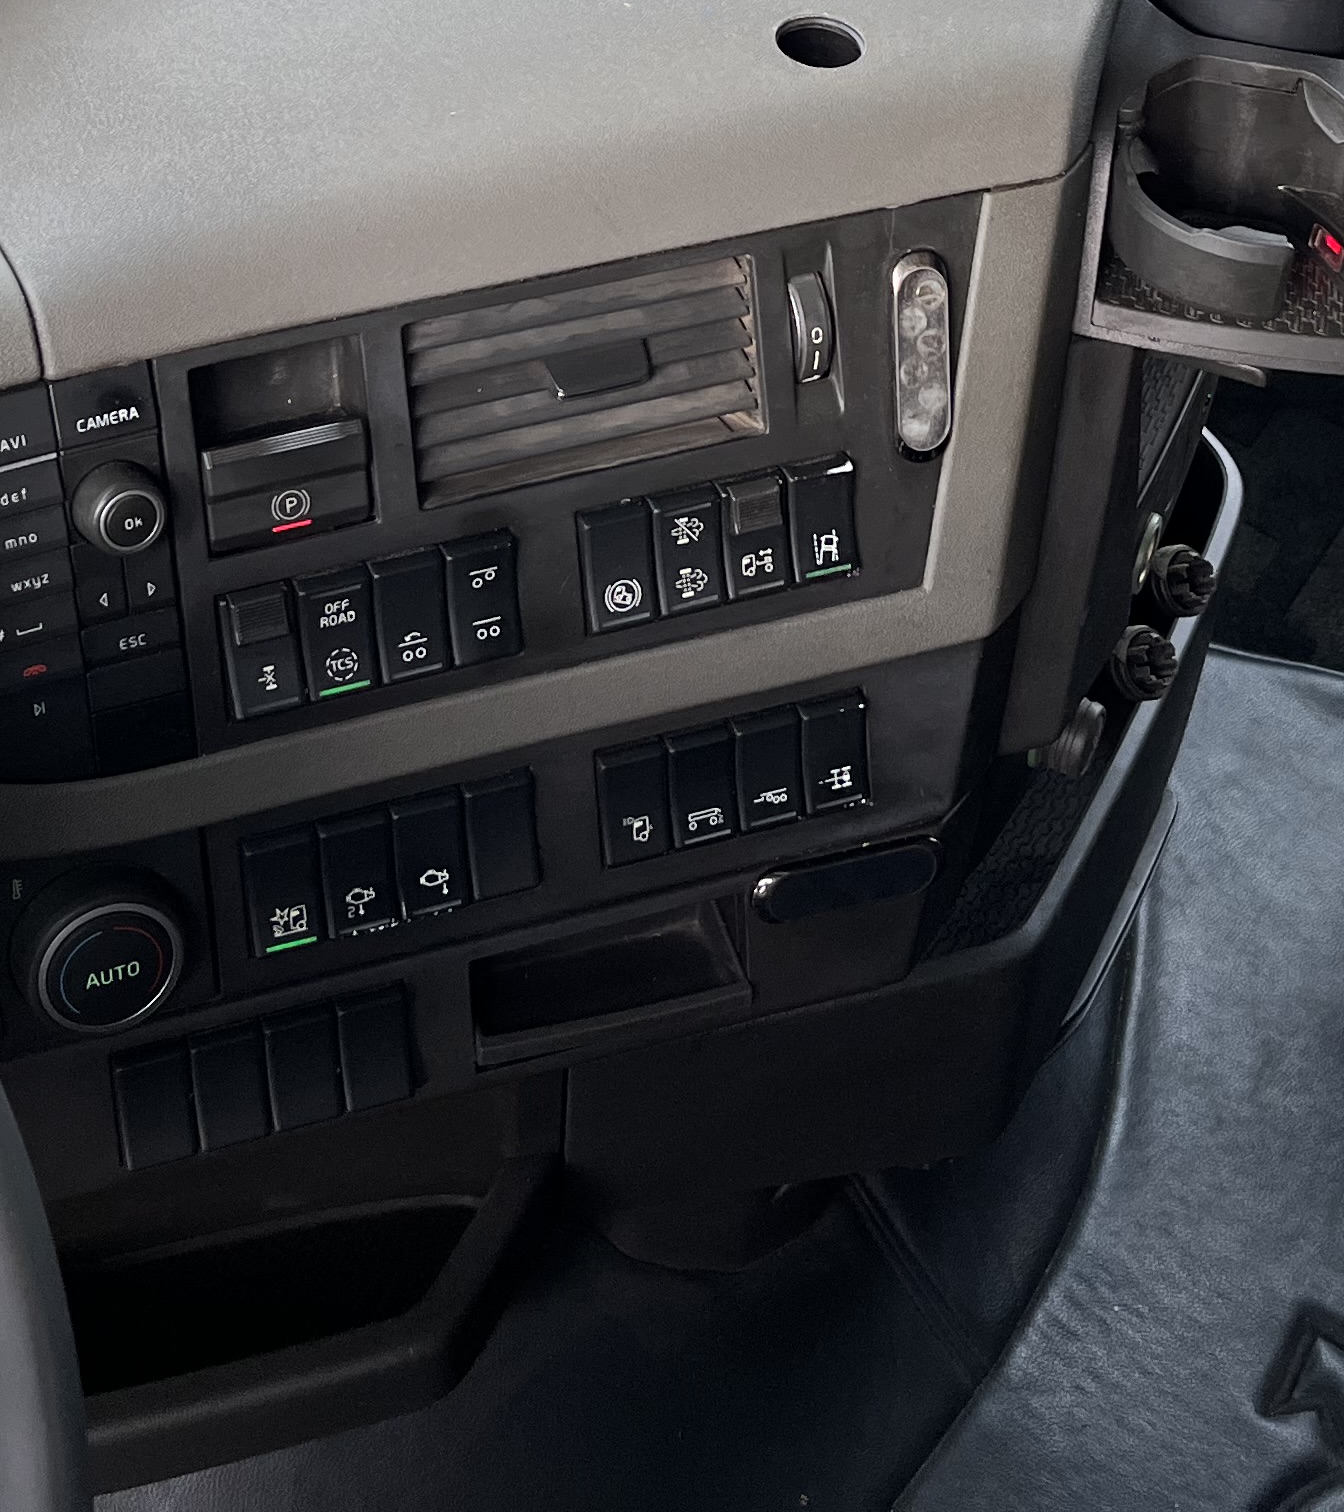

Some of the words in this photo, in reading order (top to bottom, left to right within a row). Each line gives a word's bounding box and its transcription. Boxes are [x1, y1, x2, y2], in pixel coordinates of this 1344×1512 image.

[76, 406, 140, 433] CAMERA
[0, 488, 28, 507] def
[4, 532, 38, 550] mno
[10, 573, 50, 593] wxyz
[324, 598, 351, 616] OFF
[319, 609, 356, 629] ROAD
[119, 633, 147, 651] ESC
[329, 656, 355, 674] TCS
[85, 961, 140, 990] AUTO
